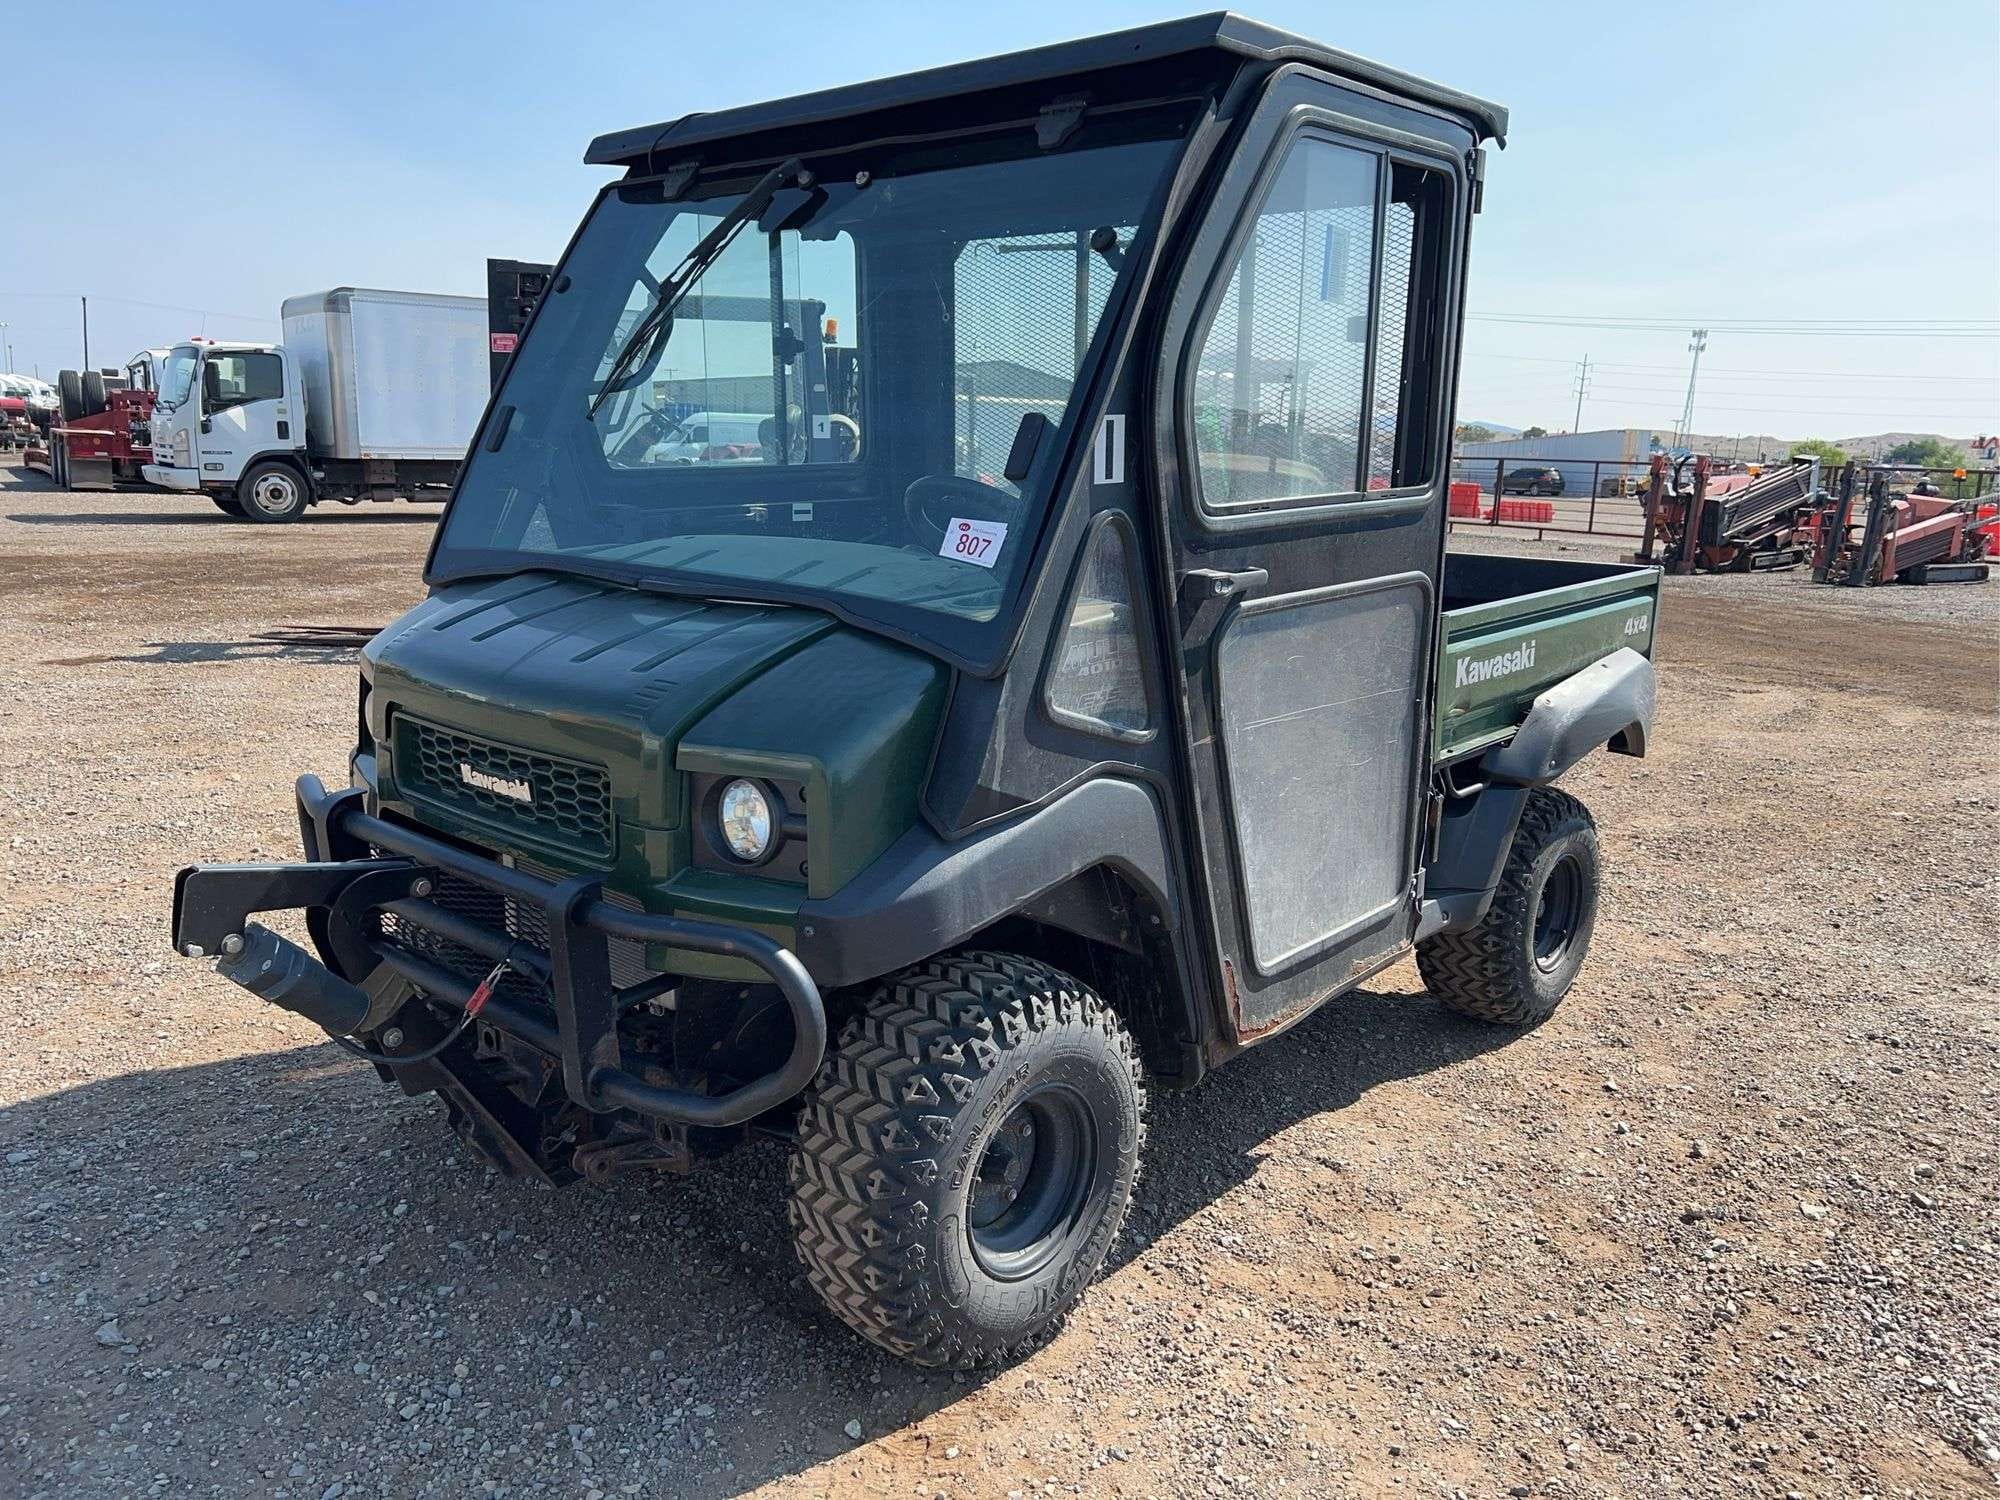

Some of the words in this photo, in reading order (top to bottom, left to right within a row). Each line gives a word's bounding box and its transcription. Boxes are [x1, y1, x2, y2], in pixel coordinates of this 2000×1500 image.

[956, 533, 992, 557] 807
[1624, 614, 1648, 636] 4x4
[1455, 639, 1536, 688] Kawasaki
[460, 762, 532, 802] Kawasaki
